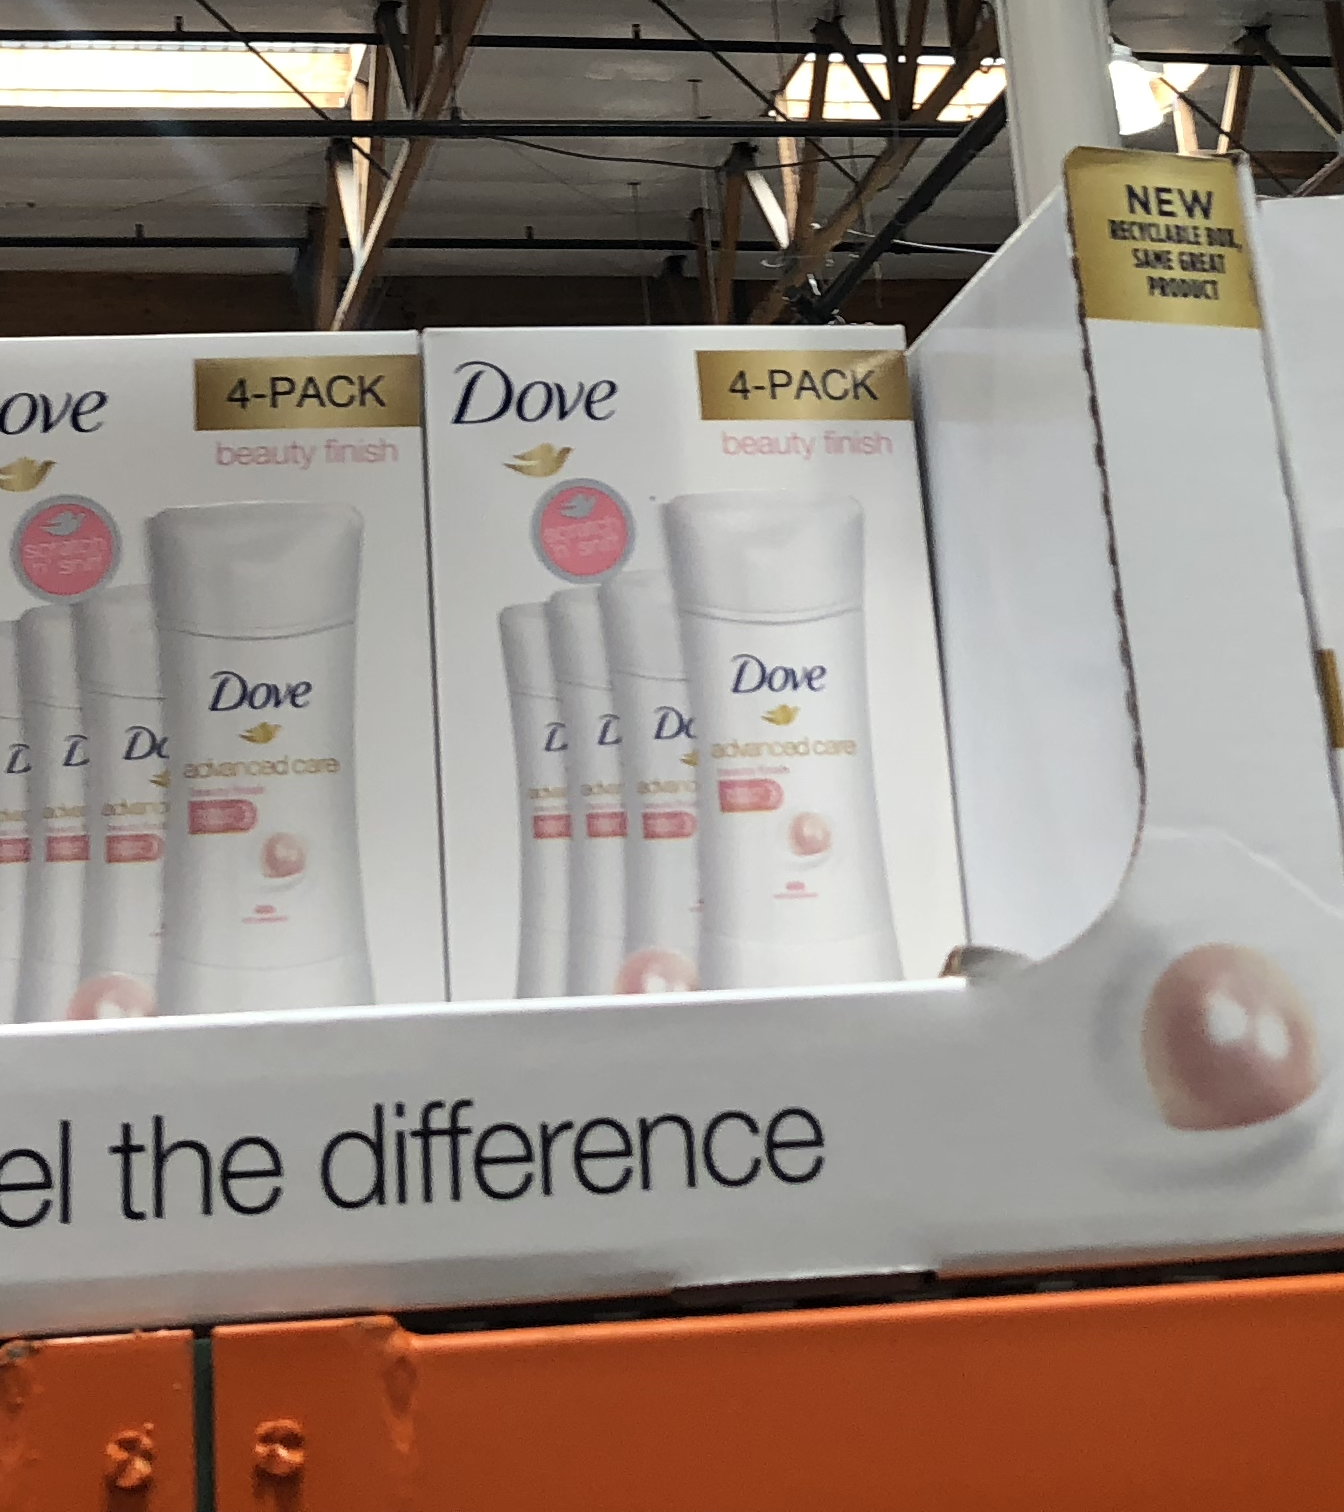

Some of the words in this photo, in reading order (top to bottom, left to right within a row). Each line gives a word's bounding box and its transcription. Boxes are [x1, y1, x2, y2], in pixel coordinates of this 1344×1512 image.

[1125, 184, 1215, 220] NEW
[1108, 219, 1202, 245] RECYCLABLE
[1132, 248, 1175, 271] SAME
[1178, 251, 1227, 274] GREAT
[1147, 276, 1219, 300] PRODUCT
[226, 374, 387, 410] 4-PACK
[451, 360, 617, 425] Dove
[728, 368, 879, 402] 4-PACK
[215, 440, 317, 470] beauty
[324, 437, 399, 465] finish
[721, 431, 816, 460] beauty
[823, 430, 893, 456] finish
[730, 653, 828, 694] Dove
[208, 671, 313, 712] Dove
[108, 1114, 284, 1223] the
[318, 1097, 826, 1212] difference
